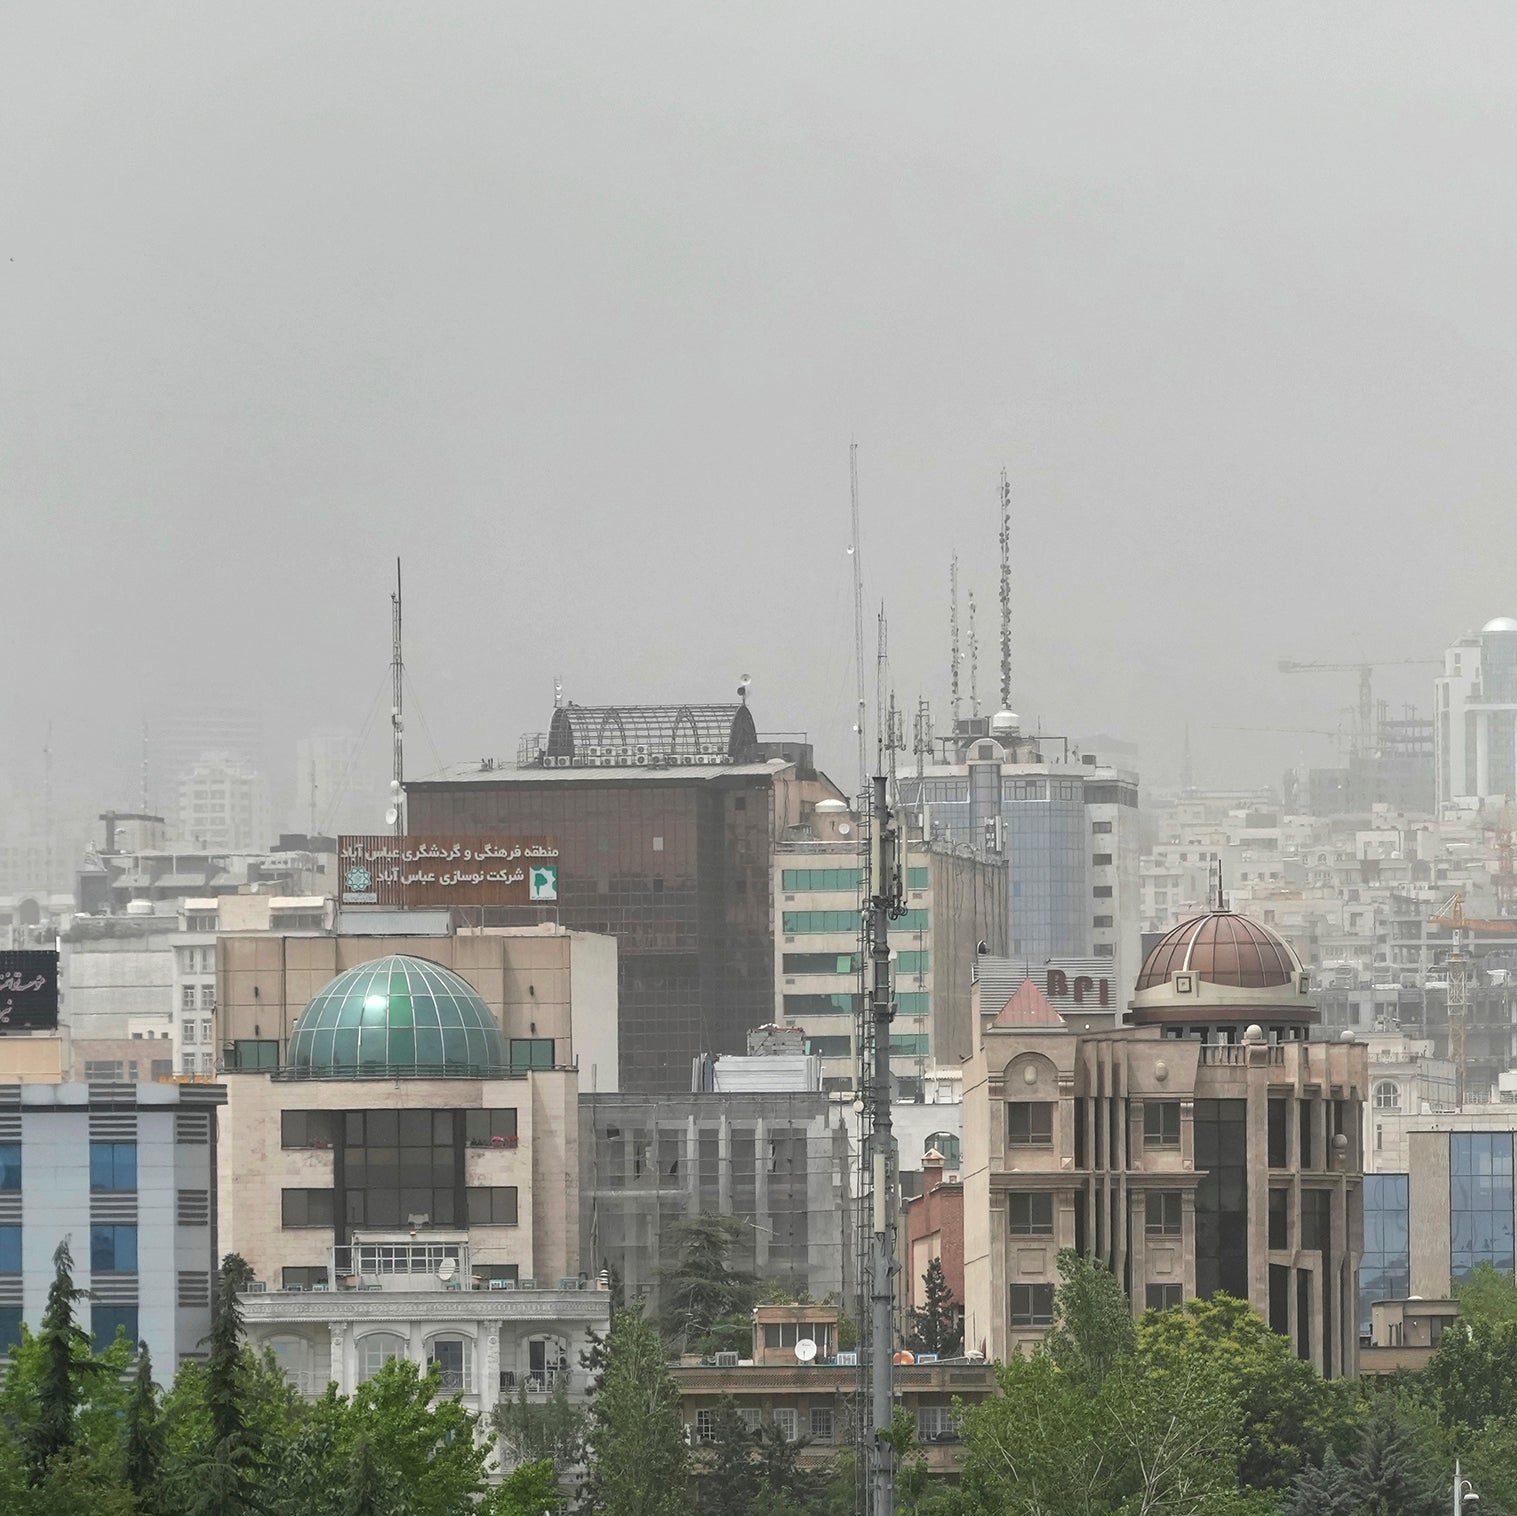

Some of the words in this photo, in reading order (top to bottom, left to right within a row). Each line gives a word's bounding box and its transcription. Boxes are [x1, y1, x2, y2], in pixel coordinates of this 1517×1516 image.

[340, 844, 363, 858] آباد
[366, 846, 400, 861] عباس
[402, 843, 460, 861] گردشگری
[463, 851, 471, 861] و
[474, 843, 521, 861] فرهنگی
[524, 846, 559, 859] منطقه
[376, 867, 399, 882] آباد
[401, 869, 435, 885] عباس
[439, 869, 484, 886] نوسازی
[487, 868, 524, 884] شرکت
